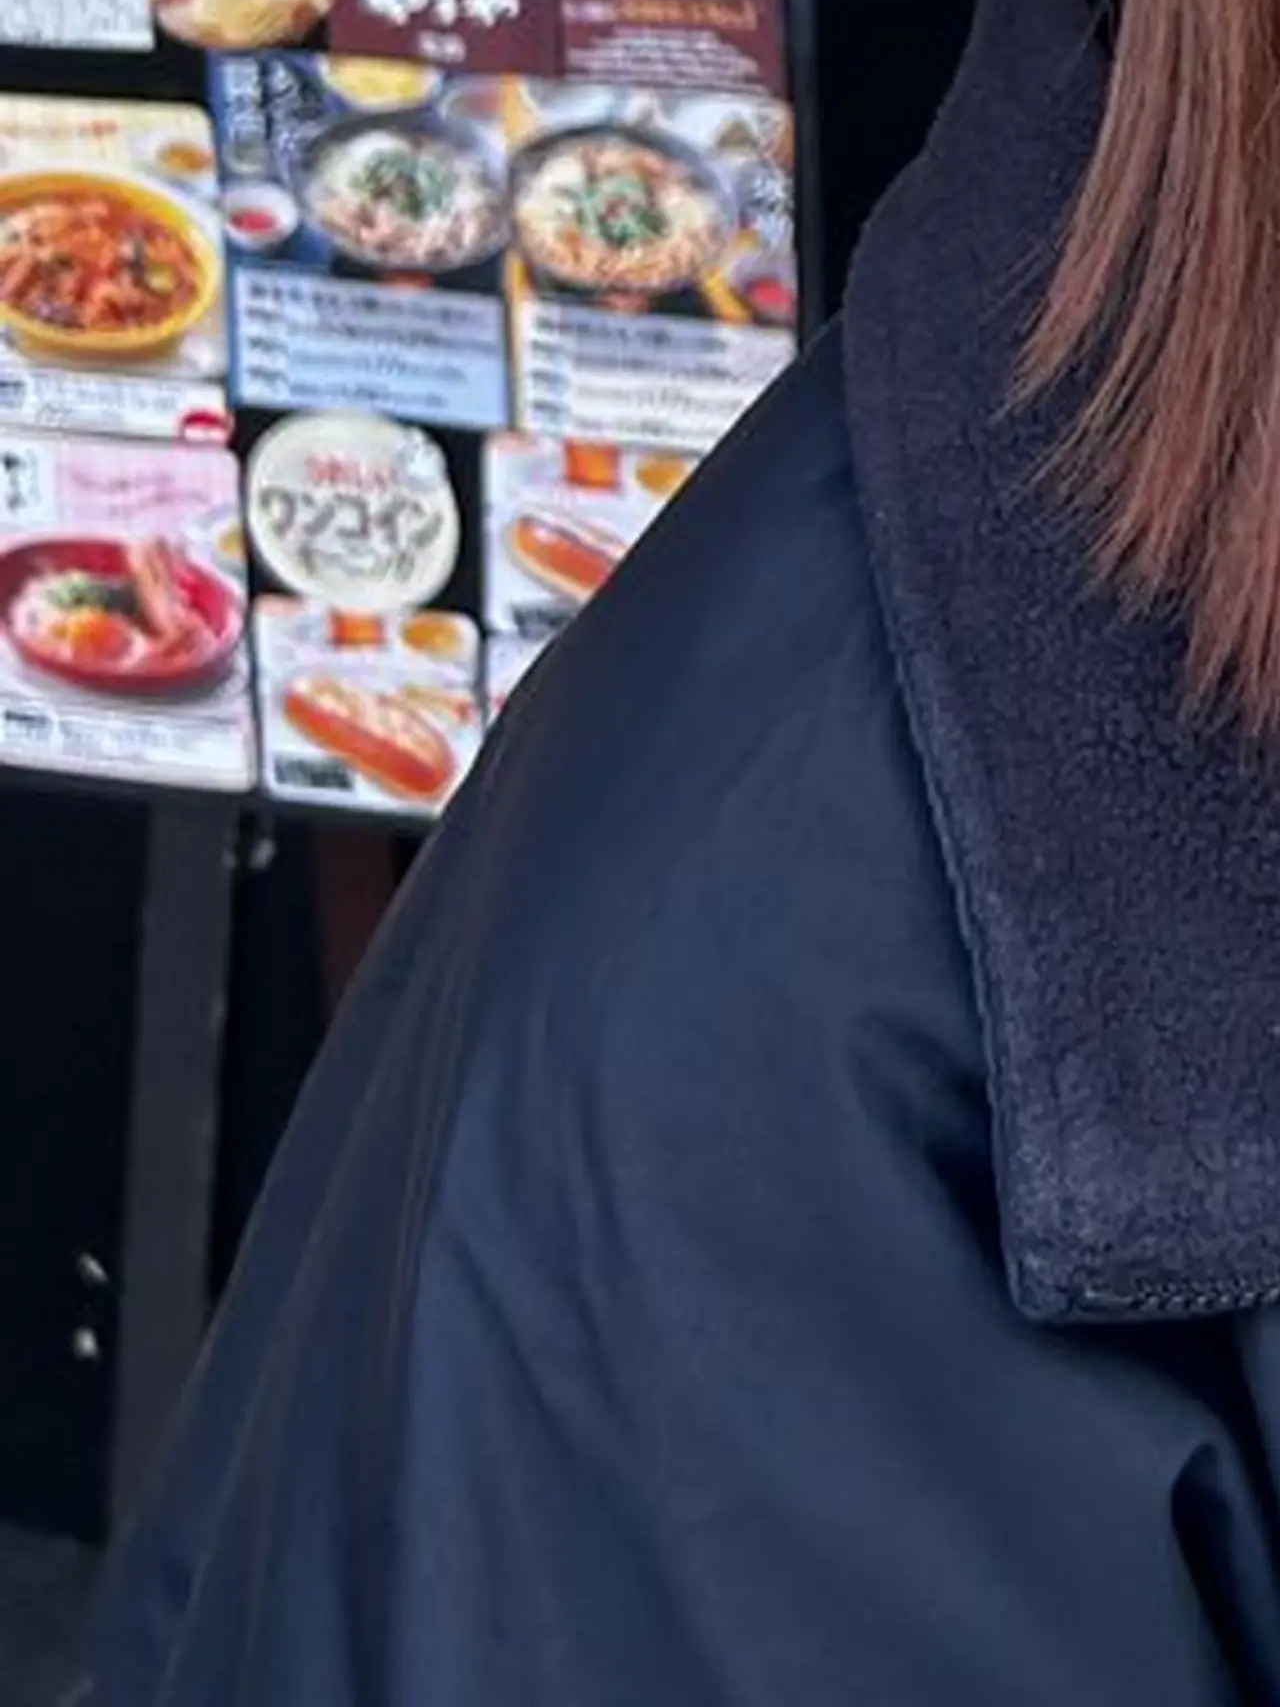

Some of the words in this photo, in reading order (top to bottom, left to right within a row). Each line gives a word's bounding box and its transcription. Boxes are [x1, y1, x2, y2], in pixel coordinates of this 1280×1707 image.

[259, 488, 444, 550] ワンコイン
